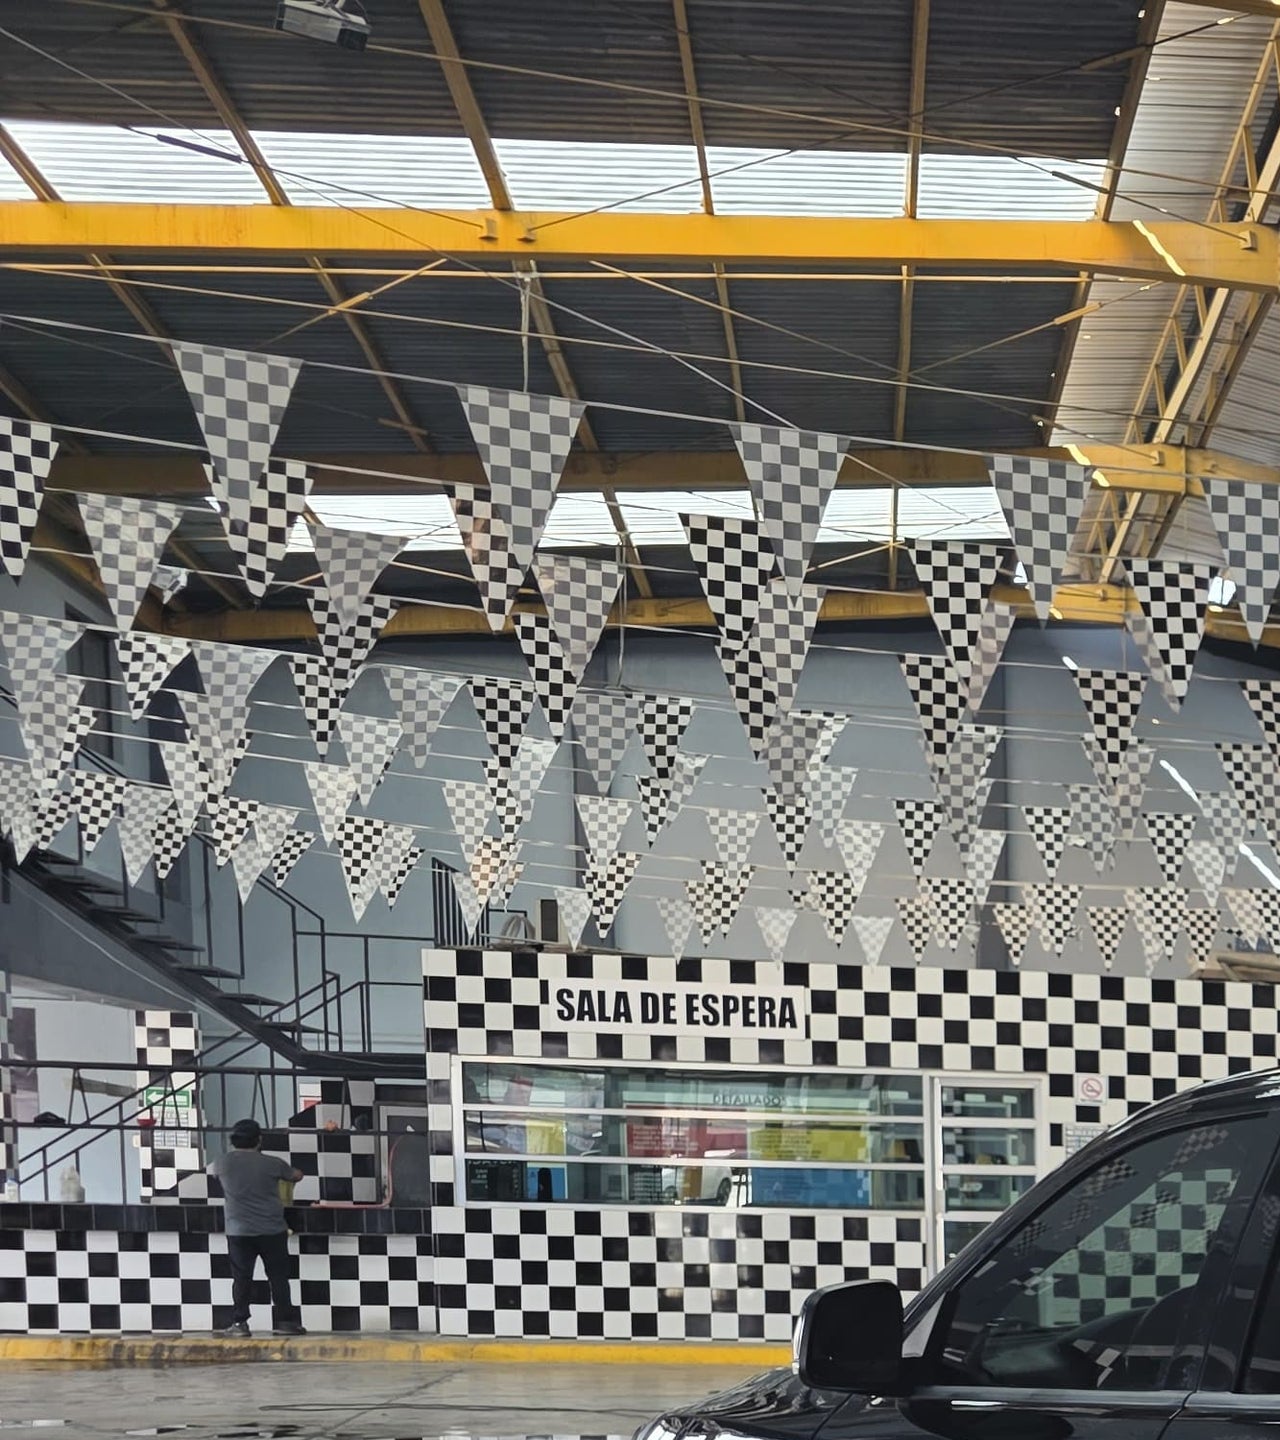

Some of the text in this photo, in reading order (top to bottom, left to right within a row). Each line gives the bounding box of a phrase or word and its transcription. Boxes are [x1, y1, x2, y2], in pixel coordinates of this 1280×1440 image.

[556, 988, 798, 1029] SALA DE ESPERA
